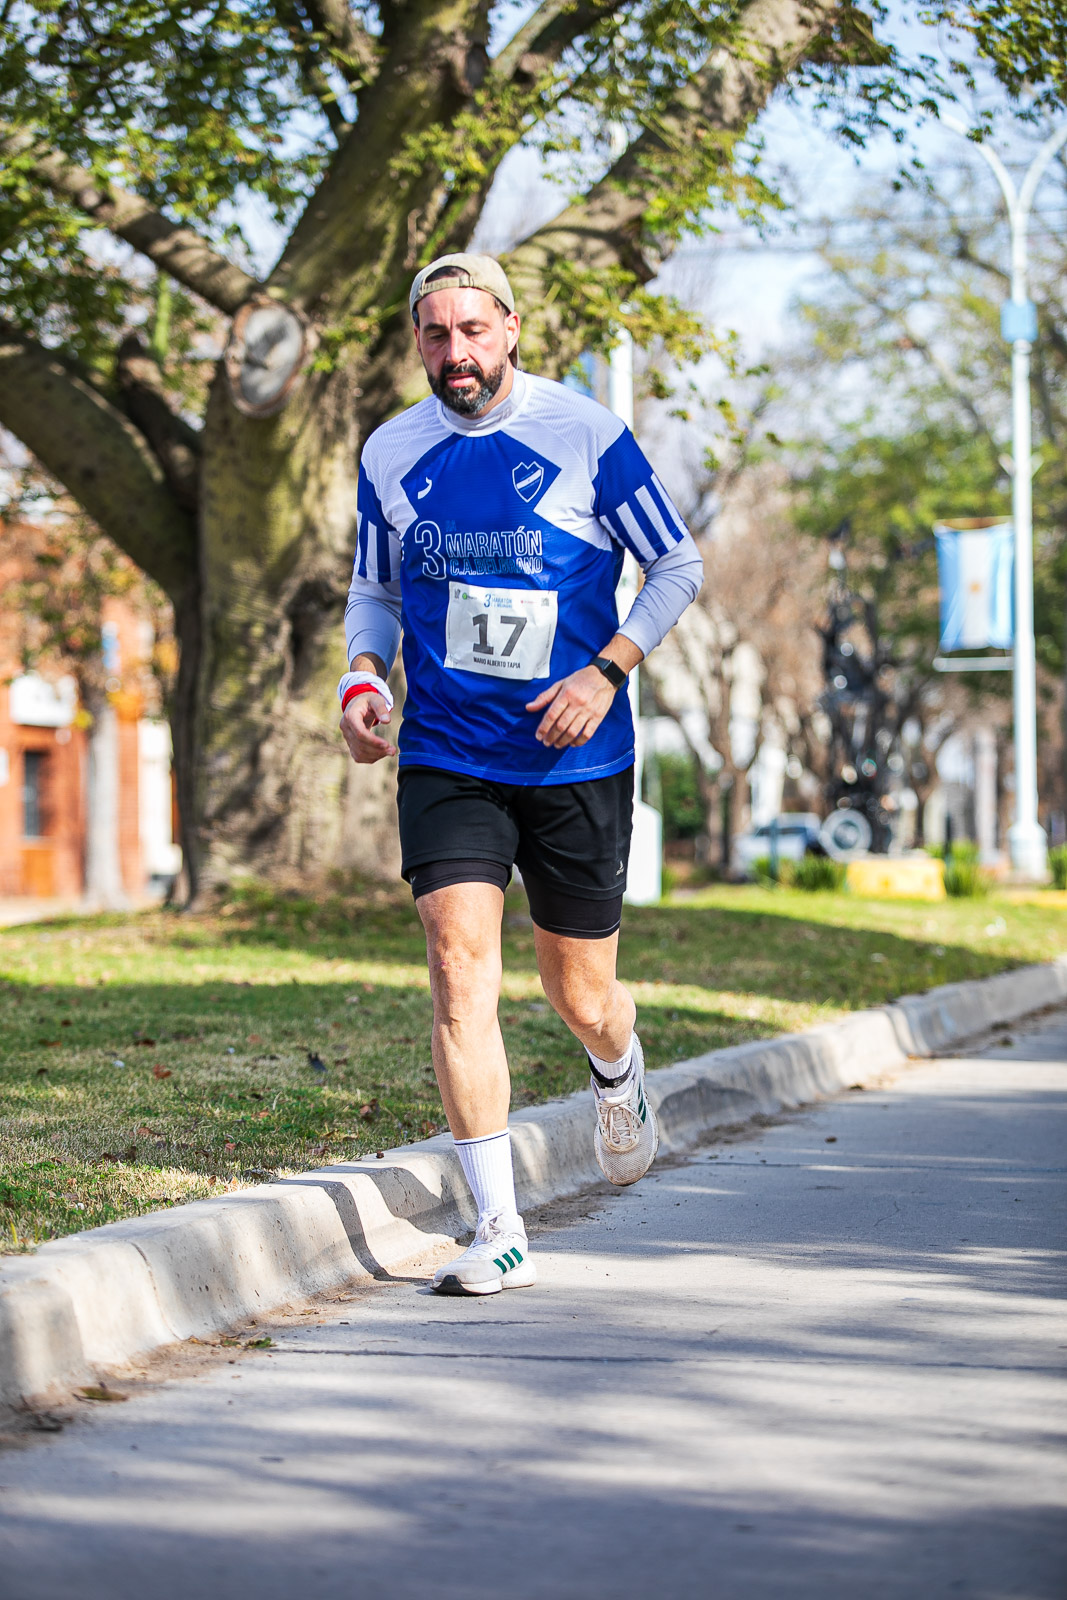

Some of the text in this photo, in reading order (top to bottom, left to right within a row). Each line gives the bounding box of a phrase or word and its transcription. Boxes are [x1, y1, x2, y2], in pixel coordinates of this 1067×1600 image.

[415, 520, 447, 580] 3
[445, 526, 543, 558] MARATÓN
[483, 593, 492, 608] 3
[472, 613, 528, 657] 17
[487, 659, 507, 668] ALBERTO
[507, 661, 521, 669] TAPIA
